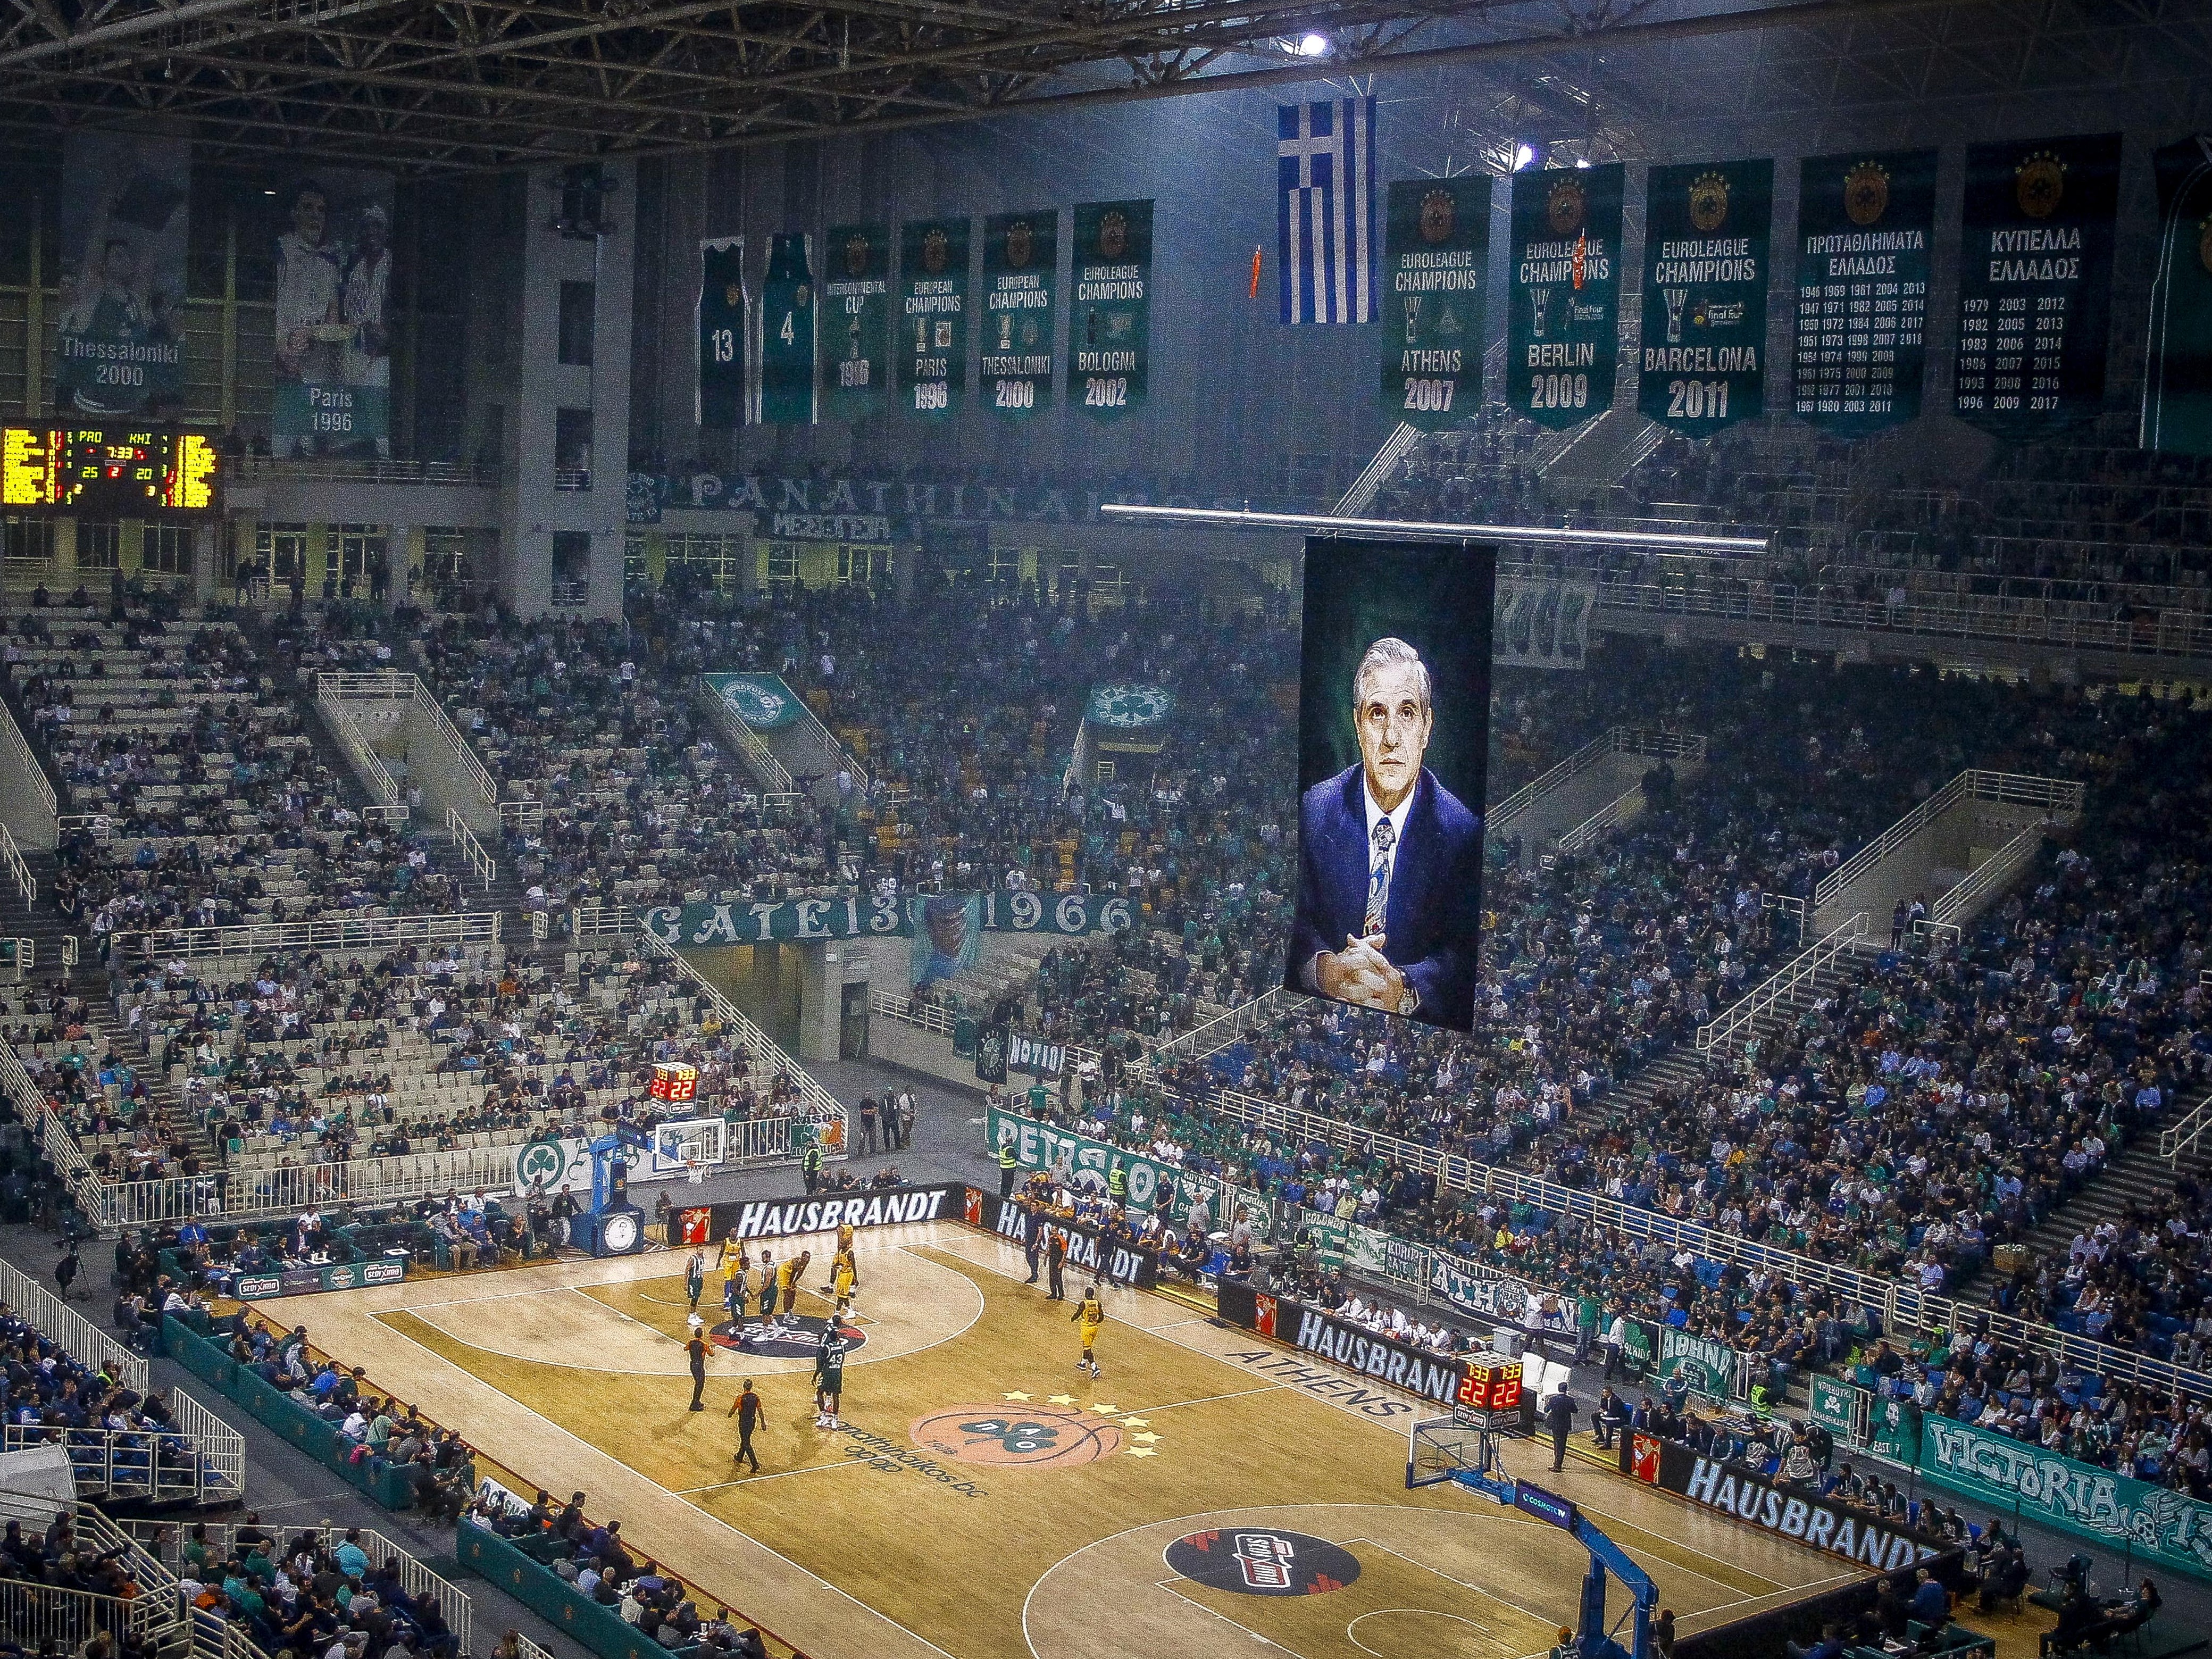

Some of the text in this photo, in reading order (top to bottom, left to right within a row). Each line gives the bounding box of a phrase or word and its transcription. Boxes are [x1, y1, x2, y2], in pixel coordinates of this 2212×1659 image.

[1663, 238, 1748, 259] EUROLEAGUE
[1991, 228, 2080, 252] ΚΥΠΕΛΛΑ
[1401, 251, 1472, 268] EUROLEAGUE
[1830, 256, 1896, 276] ΕΛΛΑΔΟΣ
[1084, 265, 1139, 280] EUROLEAGUE
[1656, 259, 1755, 283] CHAMPIONS
[1989, 257, 2079, 281] ΕΛΛΑΔΟΣ
[915, 280, 952, 295] EUROPEAN
[998, 275, 1039, 290] EUROPEAN
[1396, 270, 1476, 291] CHAMPIONS
[1876, 283, 1898, 295] 2004
[1904, 282, 1925, 294] 2013
[990, 289, 1047, 309] CHAMPIONS
[1079, 281, 1143, 301] CHAMPIONS
[846, 296, 864, 313] CUP
[906, 295, 961, 313] CHAMPIONS
[1800, 303, 1819, 314] 1947
[1823, 302, 1843, 314] 1971
[1850, 301, 1870, 313] 1982
[1902, 299, 1924, 311] 2014
[1964, 297, 2065, 312] 1979 2003 2012
[781, 311, 794, 345] 4
[1822, 318, 1843, 330] 1972
[1874, 316, 1896, 329] 2006
[1901, 316, 1923, 329] 2017
[1963, 317, 2063, 331] 1982 2005 2013
[712, 329, 732, 361] 13
[1821, 335, 1842, 346] 1973
[1848, 334, 1868, 346] 1998
[1873, 334, 1895, 345] 2007
[1961, 337, 2061, 351] 1983 2006 2014
[1079, 351, 1136, 371] BOLOGNA
[1402, 350, 1462, 372] ATHENS
[1528, 343, 1594, 366] BERLIN
[1645, 347, 1756, 372] BARCELONA
[1821, 351, 1842, 362] 1974
[1960, 357, 2060, 370] 1986 2007 2015
[916, 359, 947, 376] PARIS
[982, 356, 1050, 375] THESSALONIKI
[1872, 366, 1893, 379] 2009
[1085, 378, 1126, 406] 2002
[1531, 374, 1587, 408] 2009
[1959, 377, 1985, 389] 1993
[2032, 377, 2059, 389] 2016
[311, 388, 352, 407] Paris
[914, 381, 947, 409] 1996
[996, 380, 1033, 408] 2000
[1404, 378, 1454, 411] 2007
[1668, 380, 1728, 418] 2011
[1958, 396, 2058, 409] 1996 2009 2017
[1844, 401, 1864, 412] 2003
[1869, 401, 1891, 412] 2011
[311, 413, 352, 430] 1996
[129, 433, 152, 445] KHI
[106, 446, 133, 459] 7:33
[82, 466, 98, 478] 25
[111, 466, 119, 477] 2
[137, 468, 152, 480] 20
[653, 1079, 692, 1098] 22 22
[737, 1189, 947, 1238] HAUSBRANDT
[829, 1354, 843, 1364] 43
[1466, 1362, 1522, 1382] 7:33 7:33
[1224, 1351, 1413, 1416] ATHENS
[1459, 1378, 1518, 1406] 22 22
